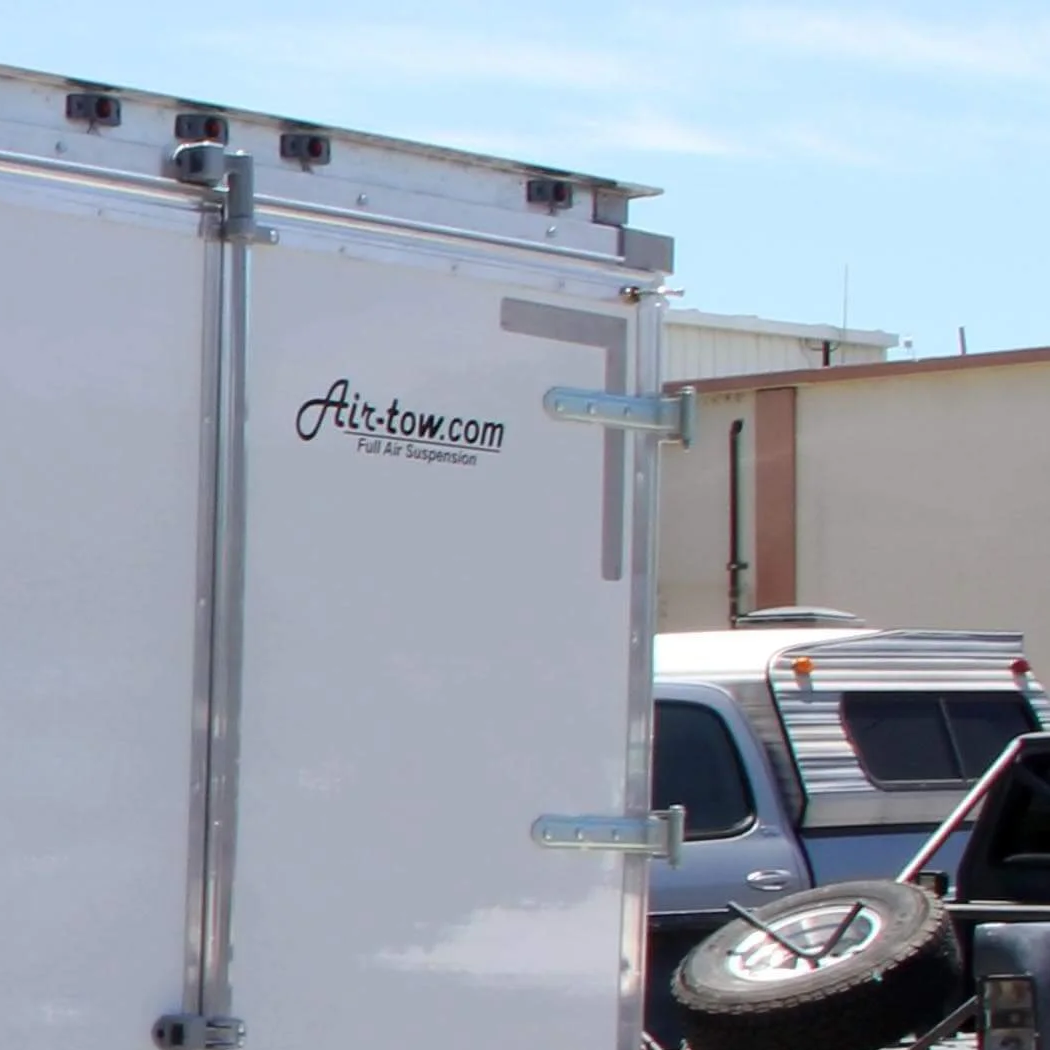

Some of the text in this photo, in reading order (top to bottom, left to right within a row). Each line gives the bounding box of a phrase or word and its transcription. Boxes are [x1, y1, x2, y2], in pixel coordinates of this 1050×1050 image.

[296, 378, 505, 448] Air-tow.com
[357, 437, 477, 466] Full Air Suspension
